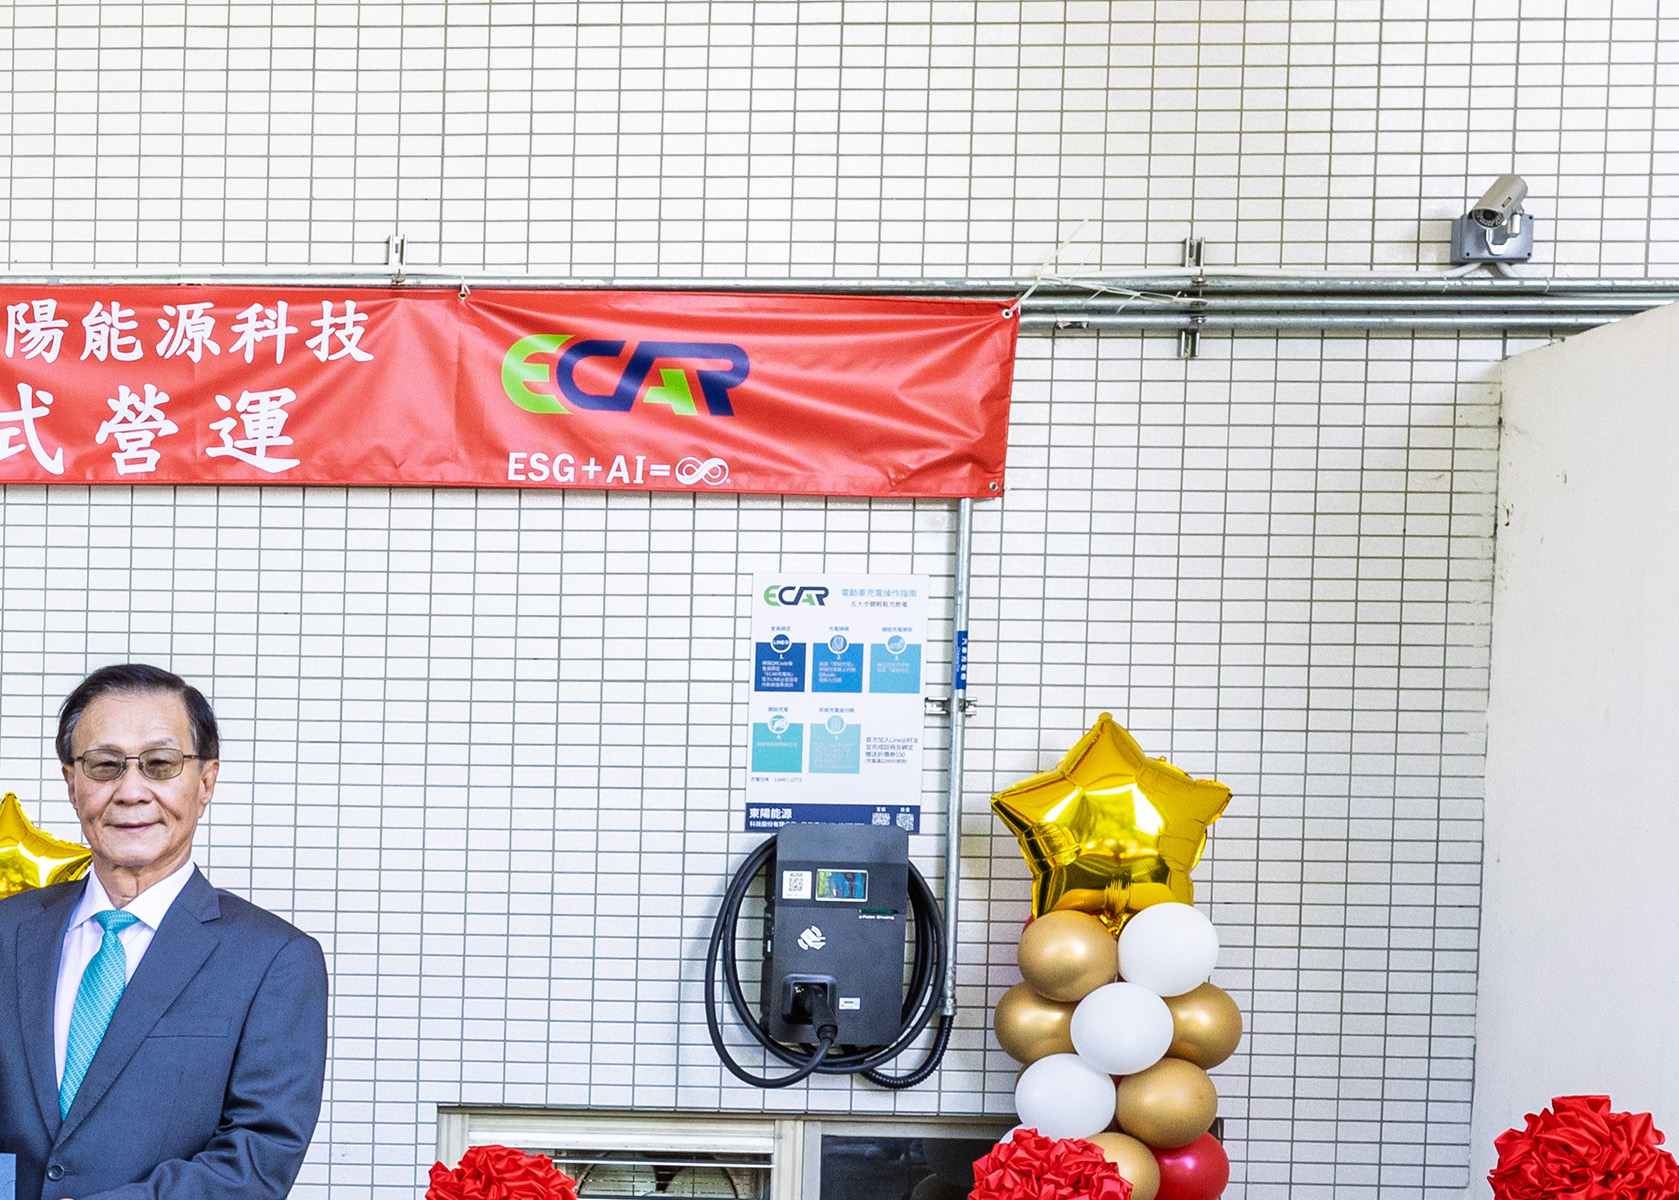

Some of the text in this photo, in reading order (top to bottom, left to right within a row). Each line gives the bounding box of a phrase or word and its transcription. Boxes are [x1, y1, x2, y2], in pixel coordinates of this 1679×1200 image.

[501, 334, 751, 417] ECAR
[764, 585, 830, 606] ECAR
[749, 808, 793, 819] 東陽能源
